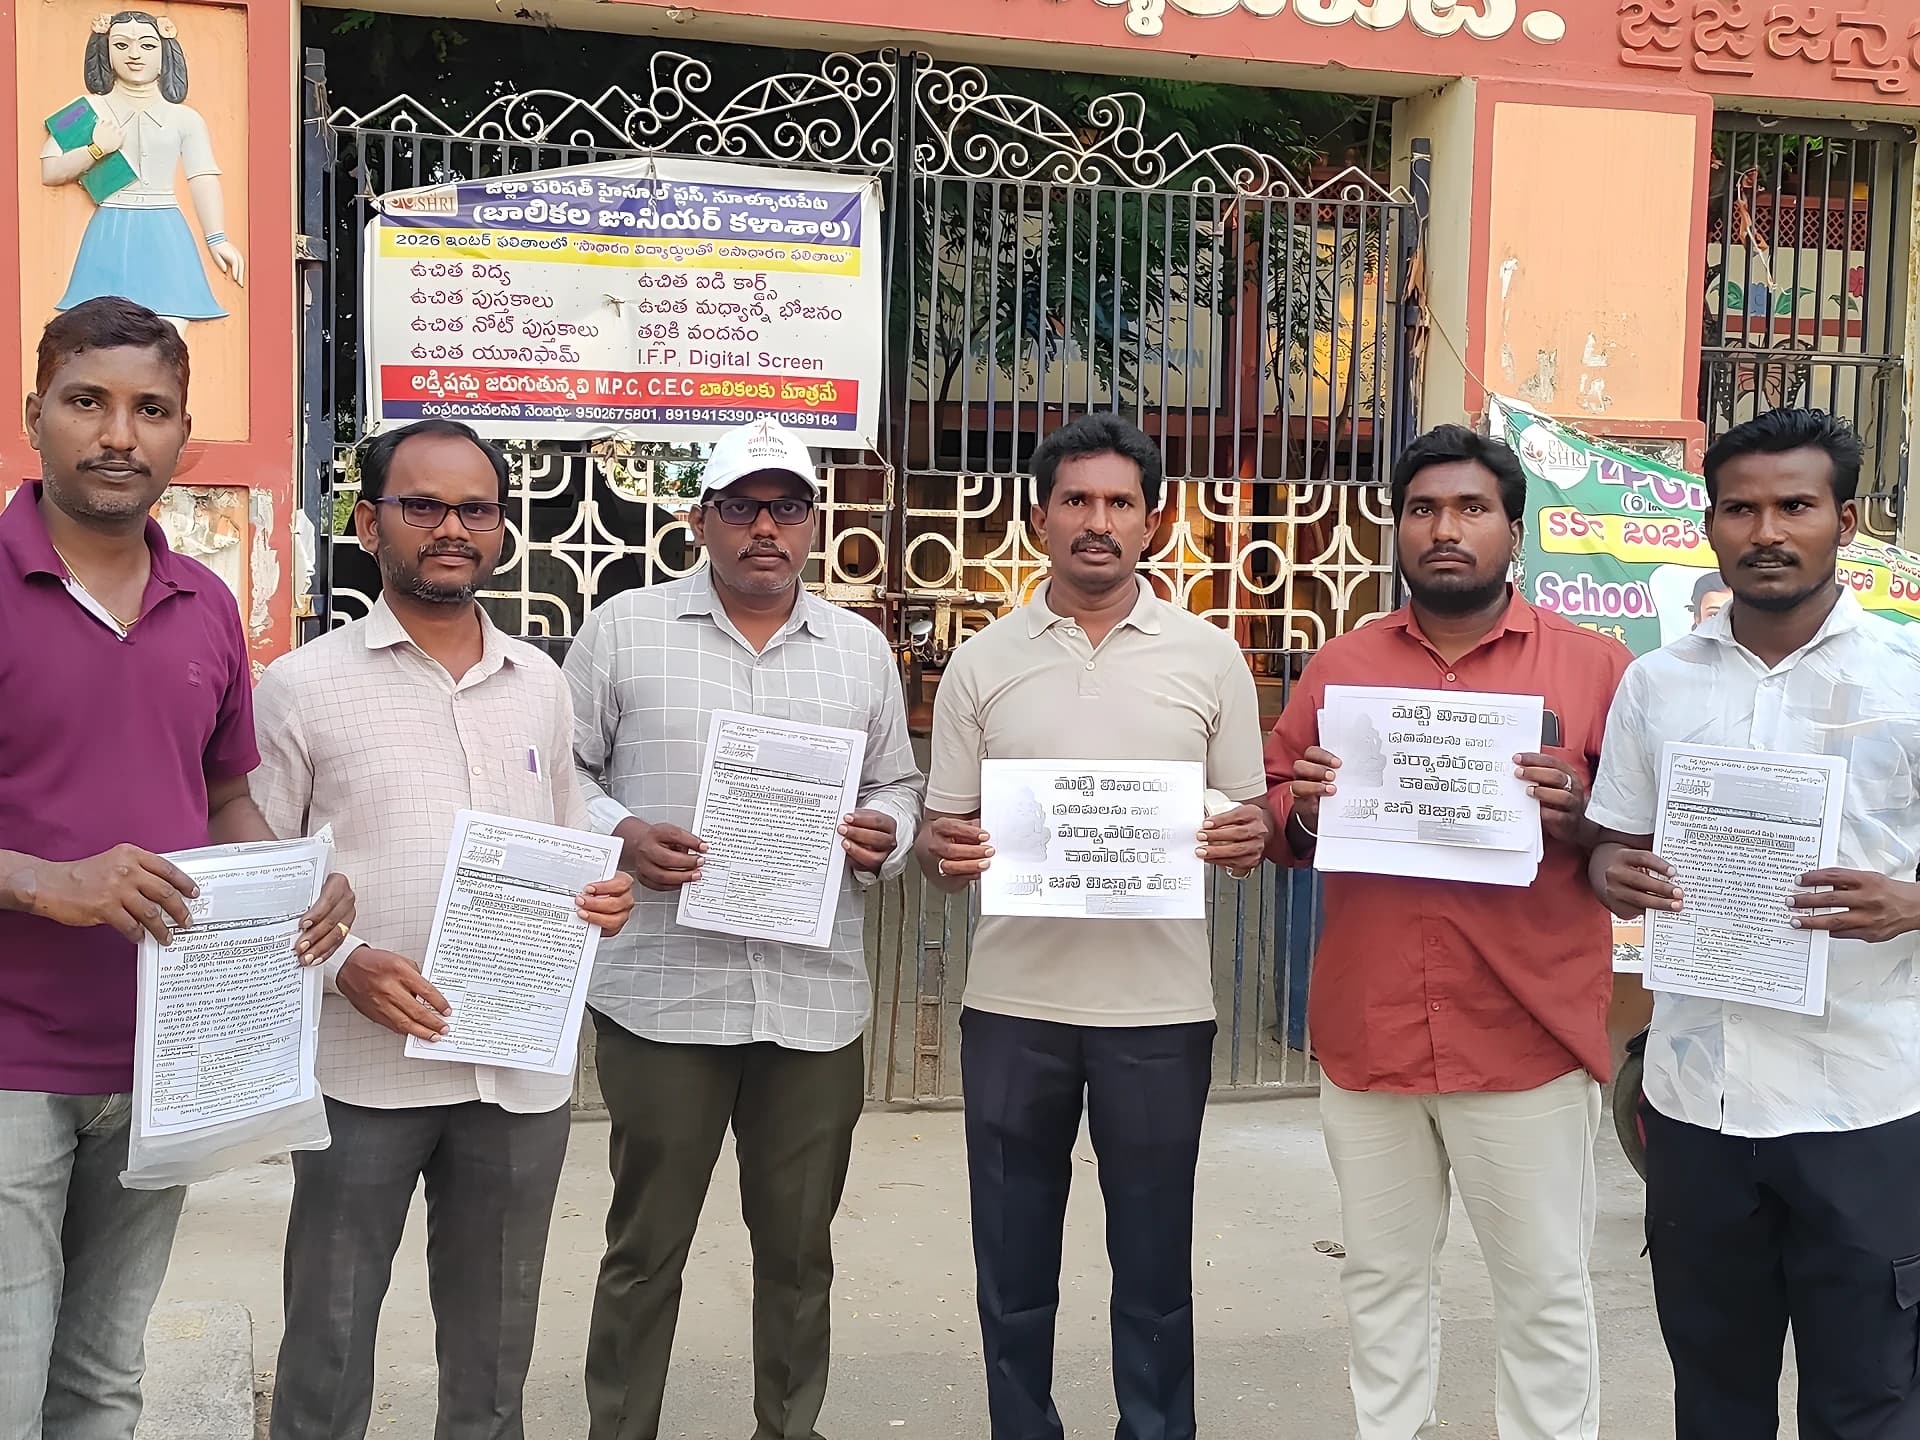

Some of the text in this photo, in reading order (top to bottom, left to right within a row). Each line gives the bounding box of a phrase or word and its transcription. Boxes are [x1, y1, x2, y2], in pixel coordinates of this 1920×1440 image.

[532, 178, 594, 197] పరిషత్
[417, 194, 454, 212] SHRI
[473, 199, 851, 241] (బాలికల జూనియర్ కళాశాల)
[395, 234, 441, 246] 2026
[445, 233, 491, 246] ఇంటర్
[410, 261, 512, 286] ఉచిత విద్య
[638, 272, 688, 288] ఉచిత
[696, 271, 726, 290] ఐడి
[410, 287, 554, 314] ఉచిత పుస్తకాలు
[638, 298, 688, 314] ఉచిత
[779, 299, 842, 321] భోజనం
[410, 314, 599, 343] ఉచిత నోట్ పుస్తకాలు
[637, 321, 759, 346] తల్లికి వందనం
[410, 342, 464, 360] ఉచిత
[690, 350, 750, 368] Digital
[758, 352, 823, 370] Screen
[648, 377, 695, 396] C.E.C
[700, 380, 775, 398] బాలికలకు
[781, 381, 837, 406] మాత్రమే
[1549, 451, 1587, 466] SHRI
[1540, 575, 1653, 614] School
